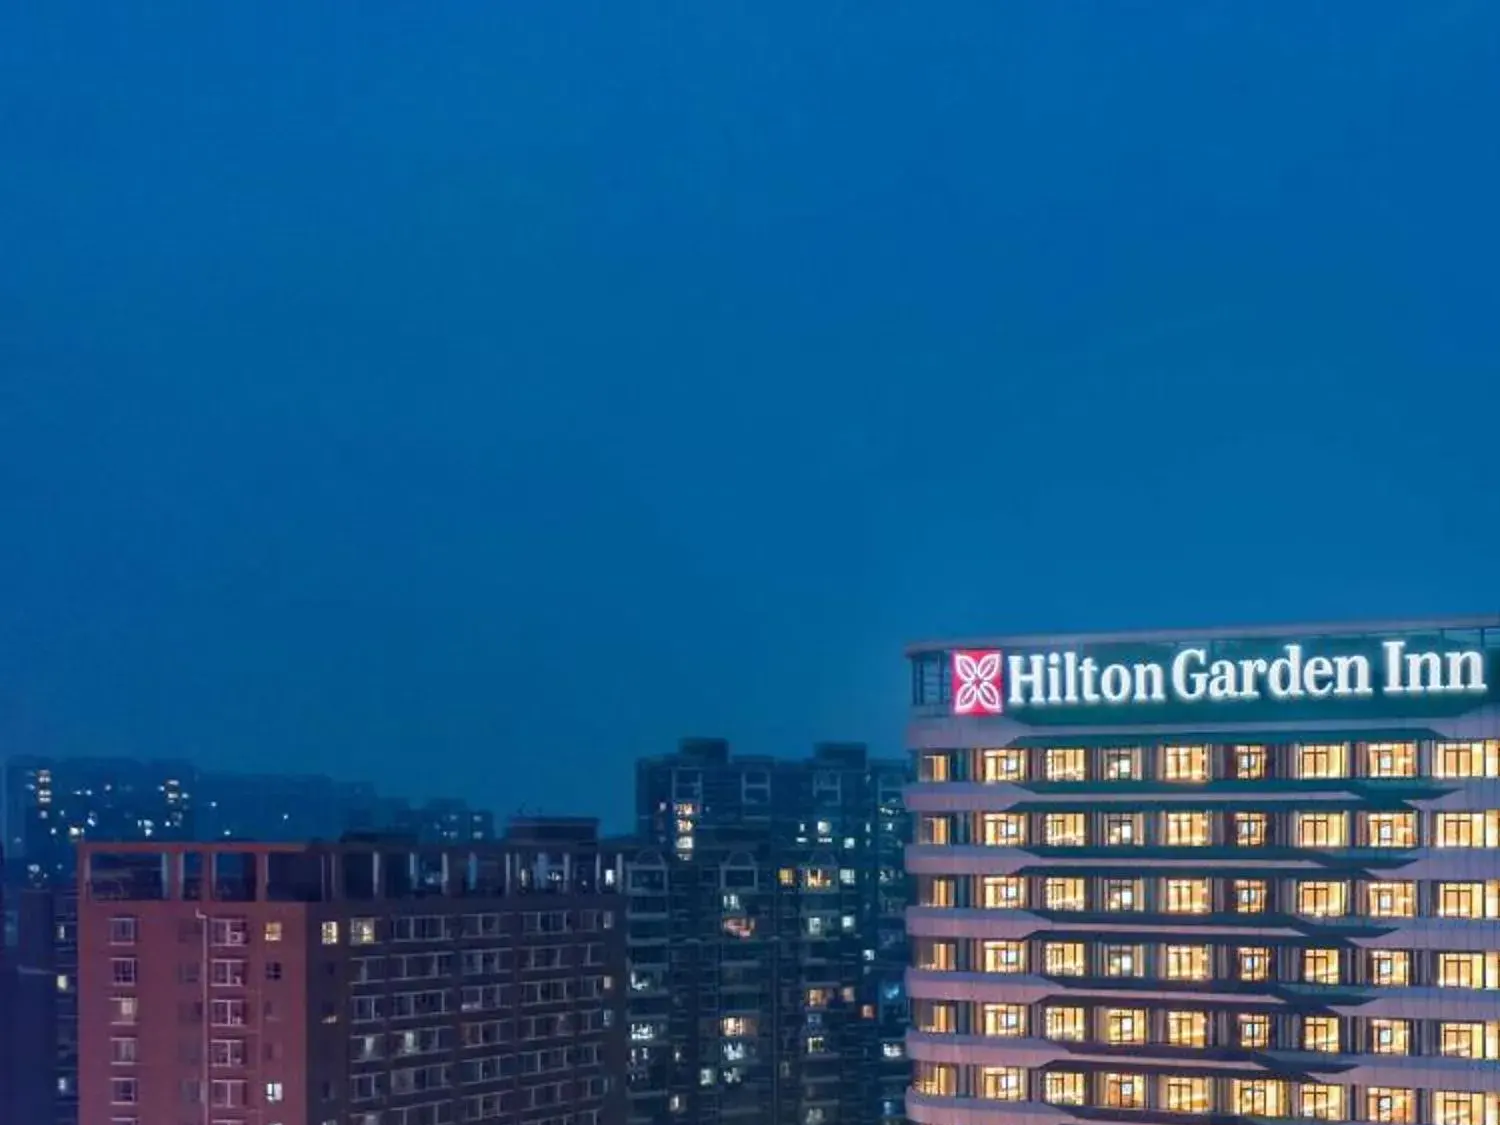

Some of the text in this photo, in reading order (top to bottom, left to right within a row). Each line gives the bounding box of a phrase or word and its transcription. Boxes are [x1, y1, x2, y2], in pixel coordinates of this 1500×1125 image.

[1007, 641, 1487, 704] Hilton Garden Inn
